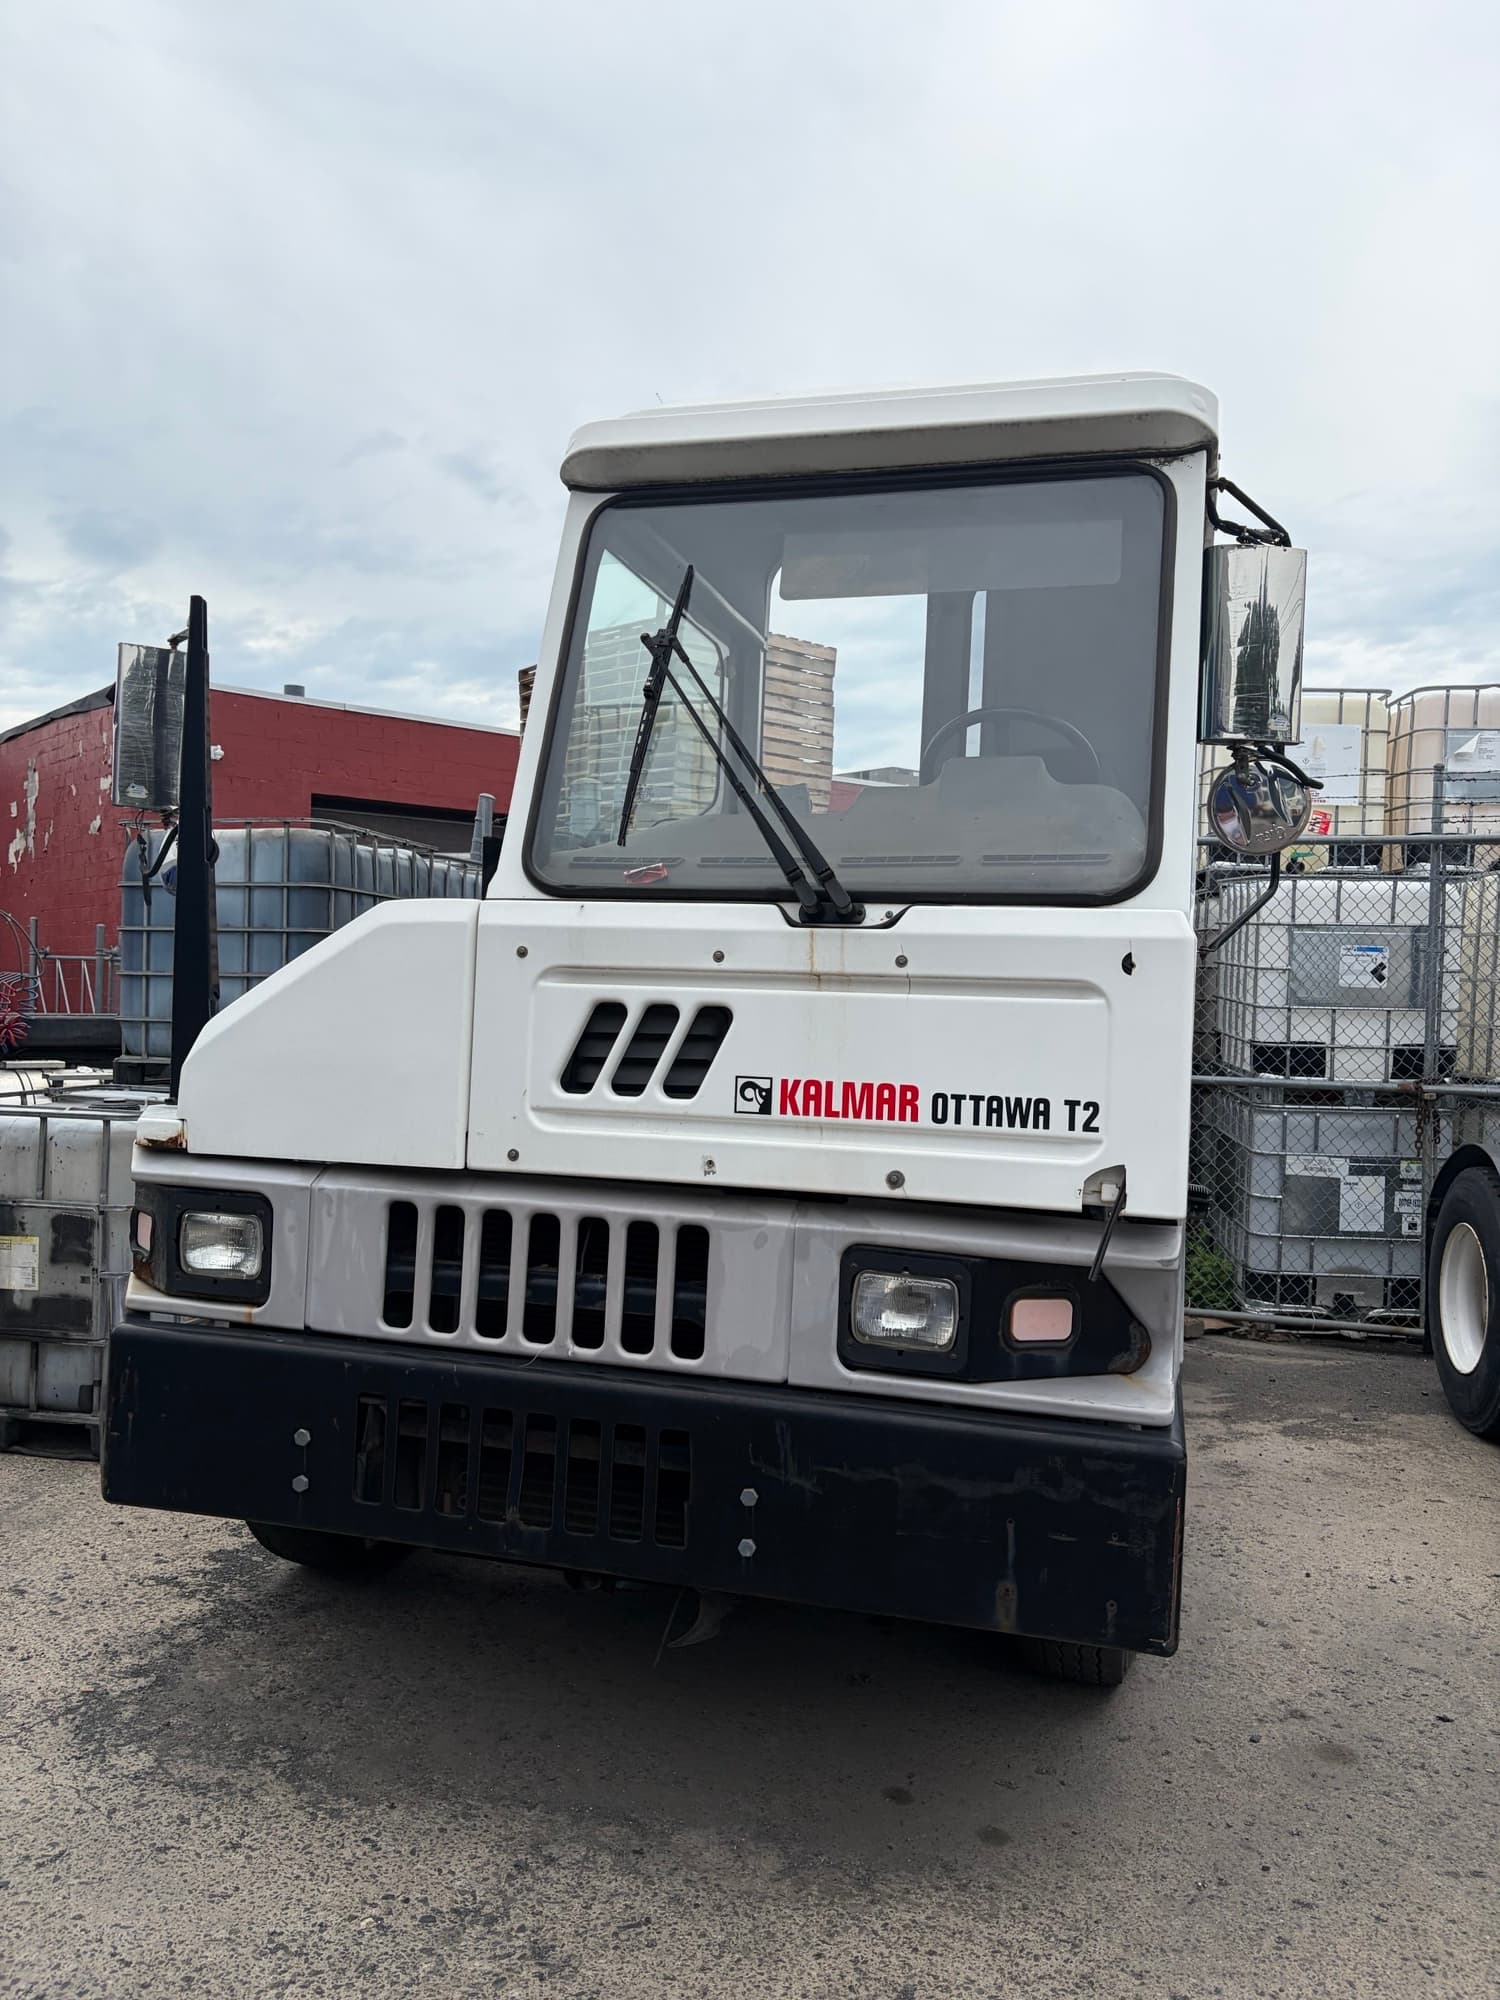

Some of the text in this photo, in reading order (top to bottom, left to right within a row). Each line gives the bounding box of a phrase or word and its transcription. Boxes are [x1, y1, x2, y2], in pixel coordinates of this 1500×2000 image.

[779, 1078, 1100, 1132] KALMAR OTTAWA T2
